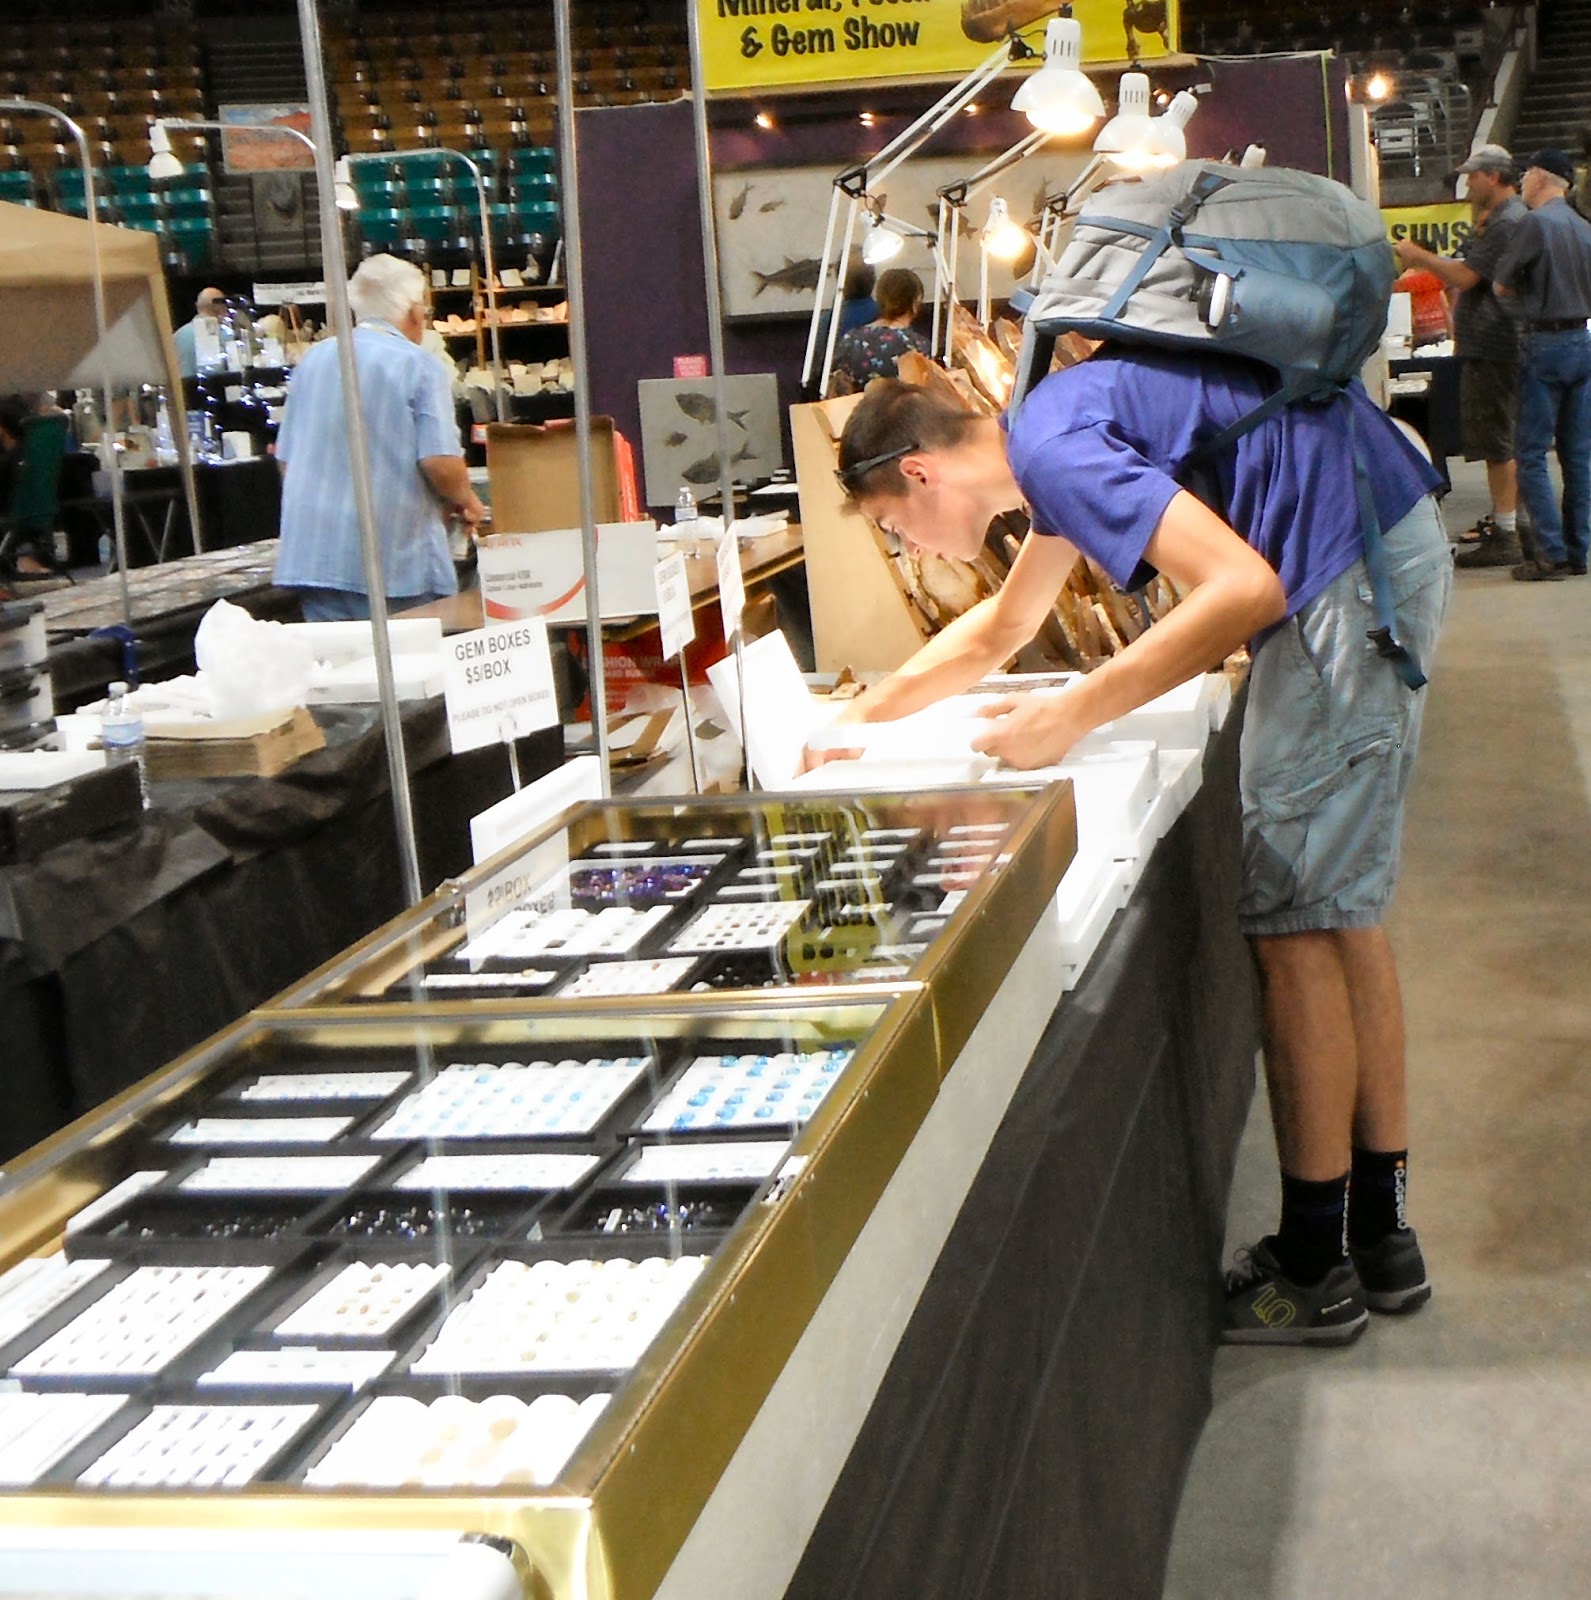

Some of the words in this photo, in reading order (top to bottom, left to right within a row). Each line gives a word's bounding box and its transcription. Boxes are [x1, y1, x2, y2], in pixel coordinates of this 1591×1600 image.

[740, 26, 764, 58] &
[771, 23, 835, 57] Gem
[843, 15, 920, 50] Show
[455, 640, 485, 661] GEM
[488, 628, 531, 654] BOXES
[465, 659, 511, 684] $5/BOX
